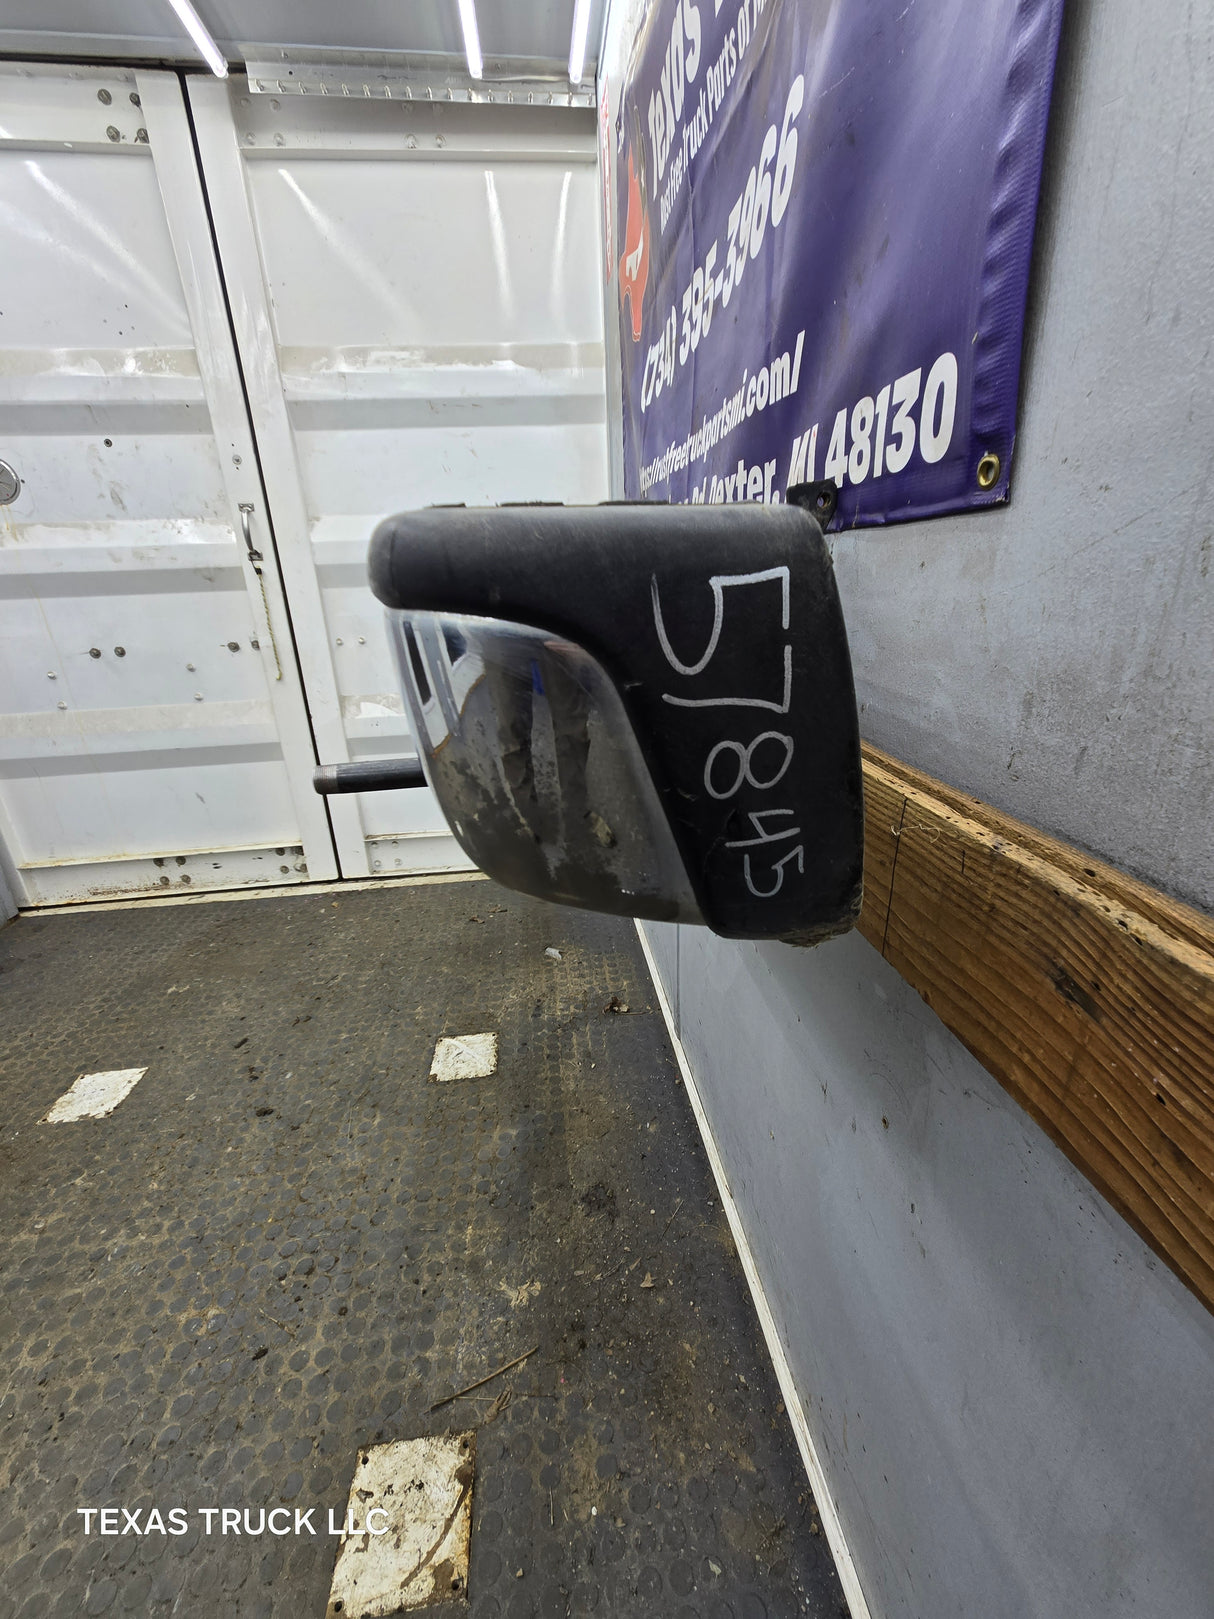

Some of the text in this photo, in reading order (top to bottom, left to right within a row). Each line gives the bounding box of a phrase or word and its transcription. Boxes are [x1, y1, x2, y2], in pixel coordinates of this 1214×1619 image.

[648, 0, 701, 200] Texas
[683, 87, 708, 173] Truck
[706, 27, 737, 124] Parts
[641, 74, 804, 413] (734) 395-3966
[784, 423, 819, 504] MI
[824, 352, 958, 489] 48130
[651, 566, 804, 897] 57845
